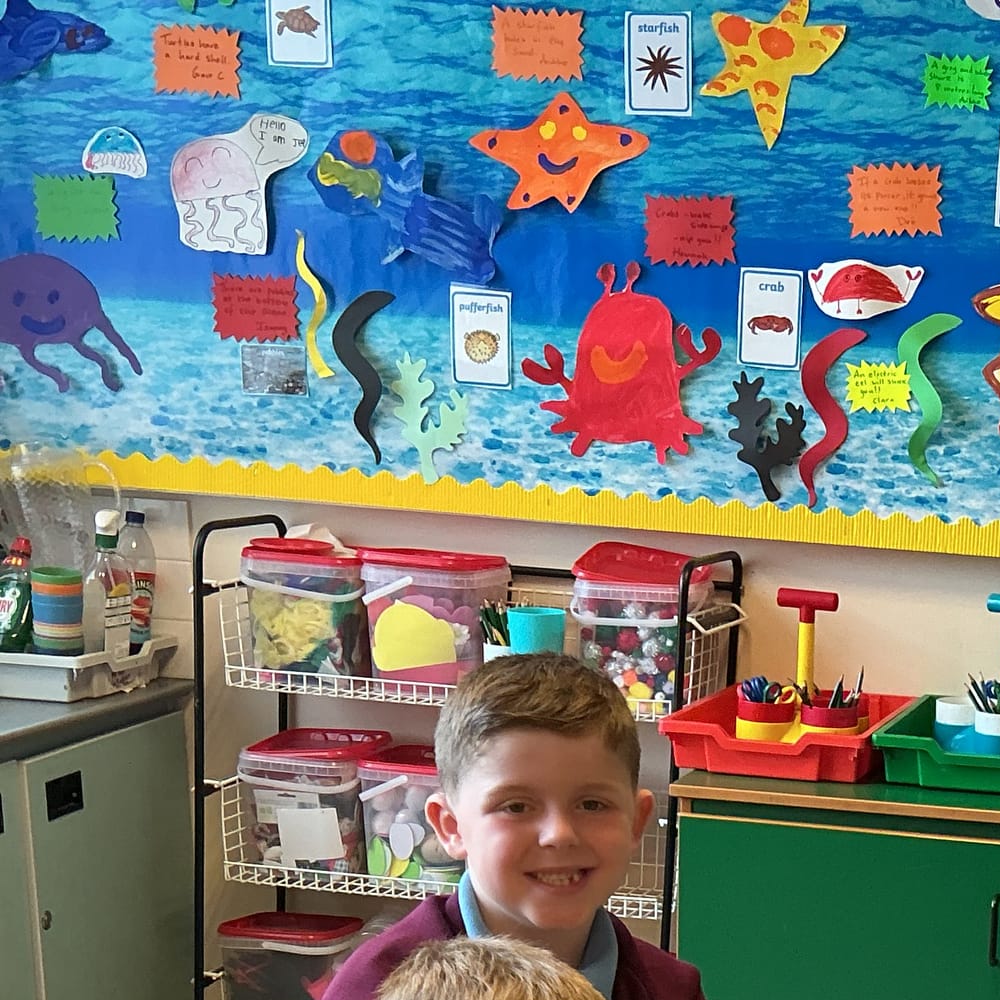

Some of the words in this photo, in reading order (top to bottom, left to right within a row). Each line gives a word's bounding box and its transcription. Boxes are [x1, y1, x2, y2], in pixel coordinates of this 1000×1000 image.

[637, 21, 680, 36] starfish
[178, 50, 200, 60] hard
[931, 61, 938, 69] A
[259, 118, 286, 131] Hello
[259, 130, 266, 140] I
[272, 135, 286, 145] am
[759, 280, 785, 293] crab
[459, 302, 503, 314] pufferfish
[854, 370, 866, 378] An
